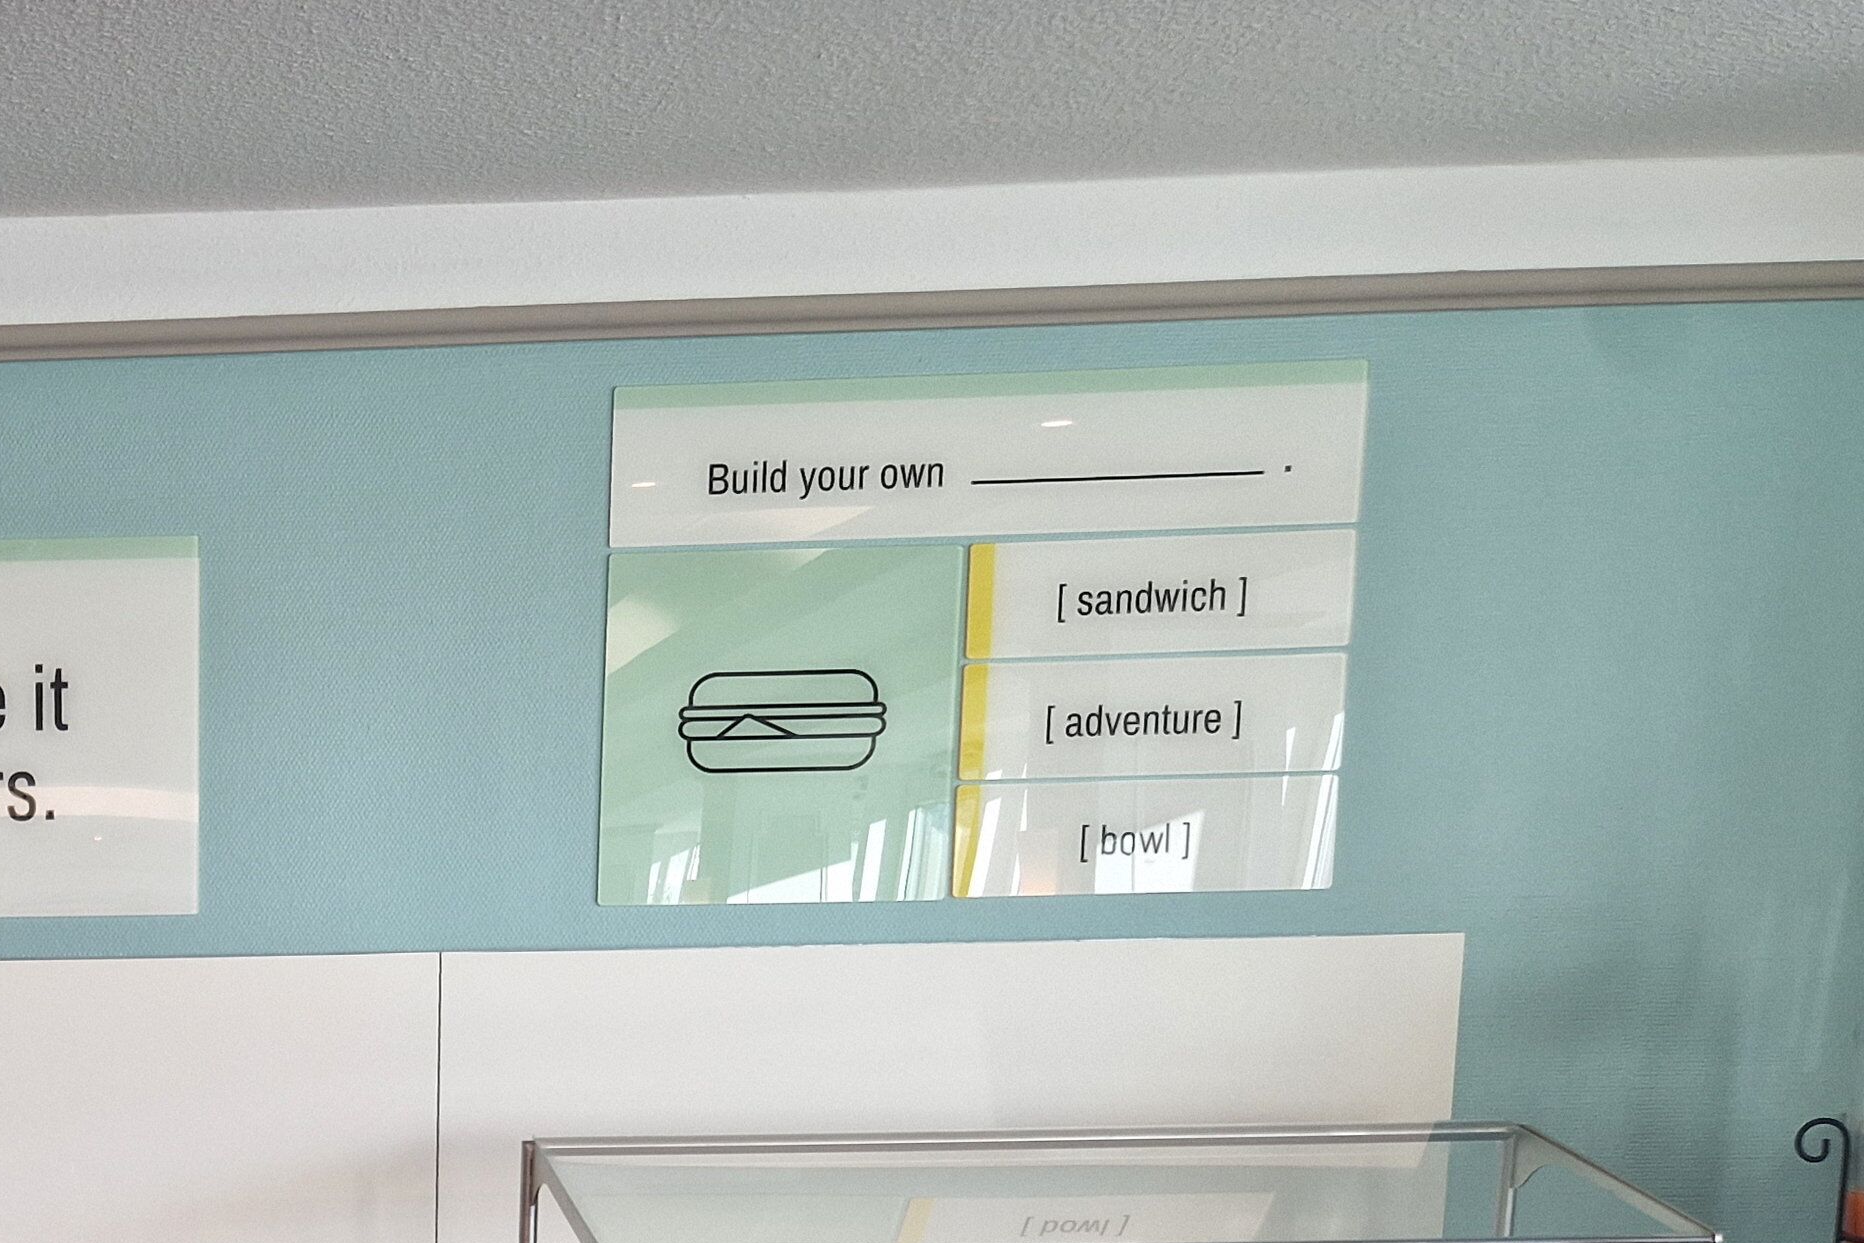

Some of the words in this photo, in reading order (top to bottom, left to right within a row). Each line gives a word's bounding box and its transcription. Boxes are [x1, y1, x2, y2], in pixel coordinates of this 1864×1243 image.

[707, 460, 787, 496] Build
[799, 464, 870, 500] your
[880, 459, 945, 490] own
[1076, 578, 1227, 617] sandwich
[35, 663, 69, 732] it
[1064, 704, 1222, 738] adventure
[1100, 824, 1171, 857] bowl
